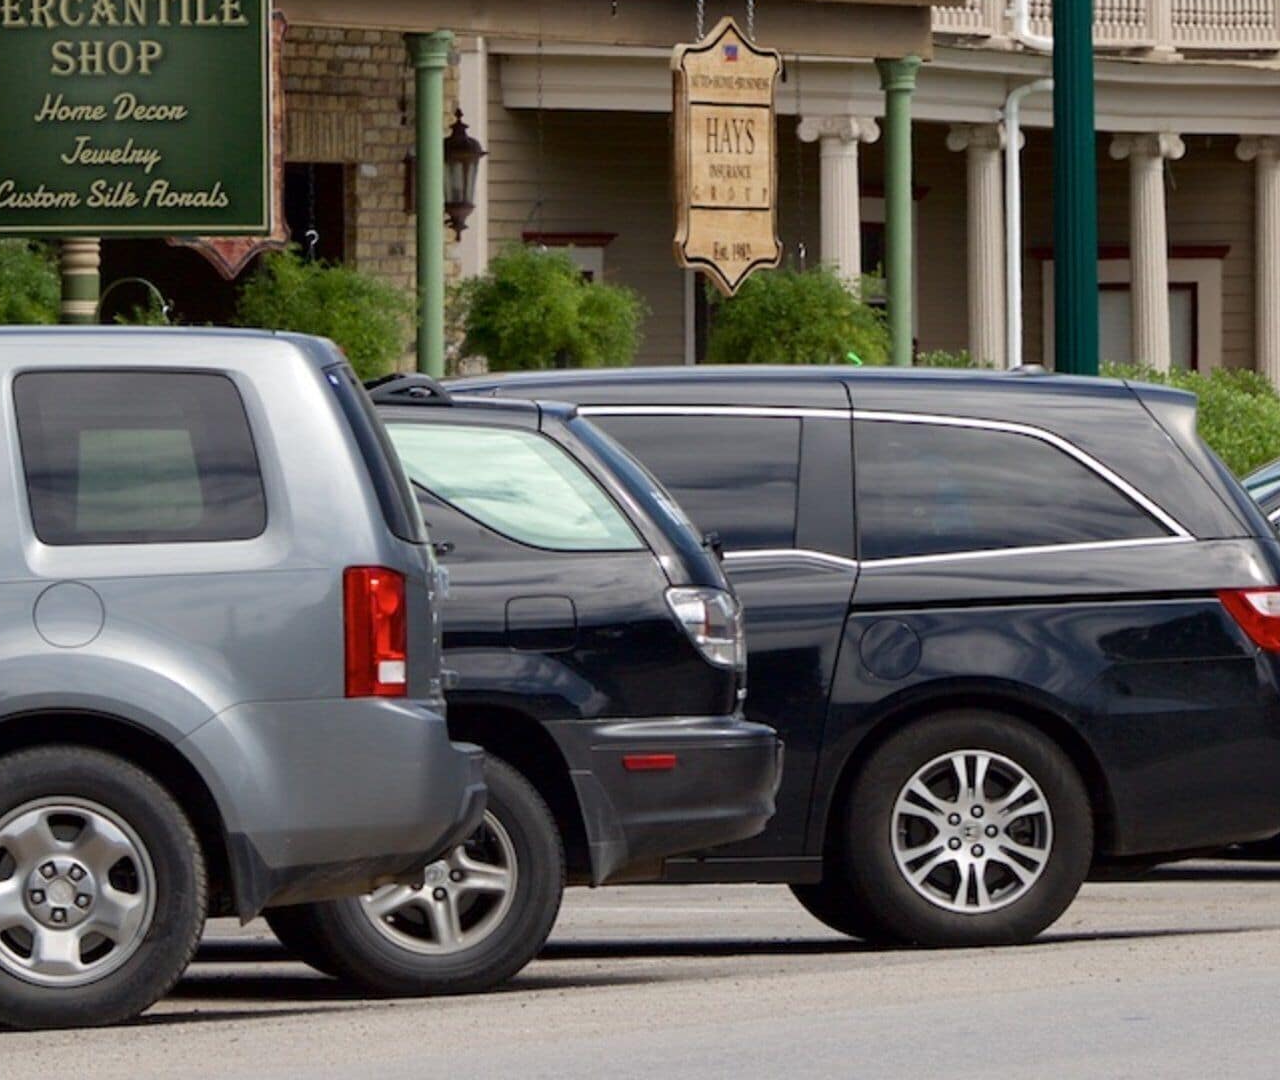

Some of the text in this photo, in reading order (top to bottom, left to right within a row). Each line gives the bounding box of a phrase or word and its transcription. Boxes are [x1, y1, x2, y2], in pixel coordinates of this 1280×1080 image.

[50, 40, 163, 76] SHOP
[34, 93, 188, 122] Home Decor
[705, 117, 756, 155] HAYS
[60, 135, 162, 174] Jewelry
[86, 179, 138, 208] Silk
[142, 180, 230, 208] Florals
